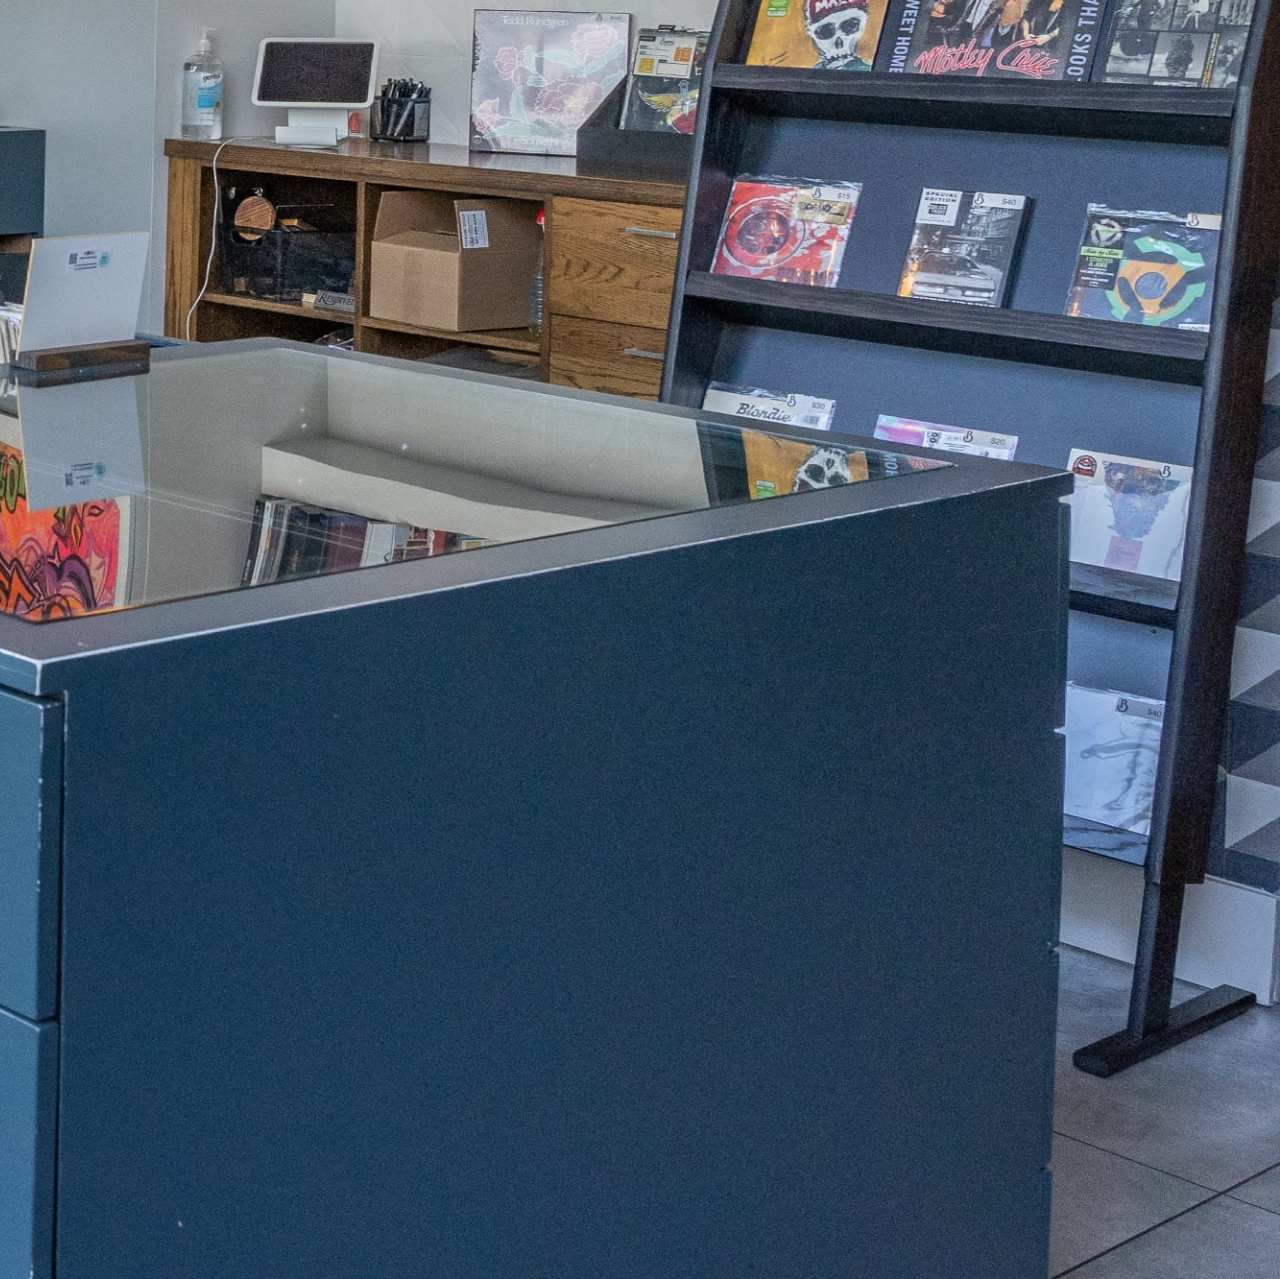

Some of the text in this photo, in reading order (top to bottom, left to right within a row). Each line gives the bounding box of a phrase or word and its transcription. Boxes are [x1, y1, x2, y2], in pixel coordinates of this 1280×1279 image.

[889, 36, 912, 74] HOME
[1066, 33, 1093, 81] OOKS
[925, 190, 958, 198] SPECIAL
[736, 402, 792, 423] Blondie
